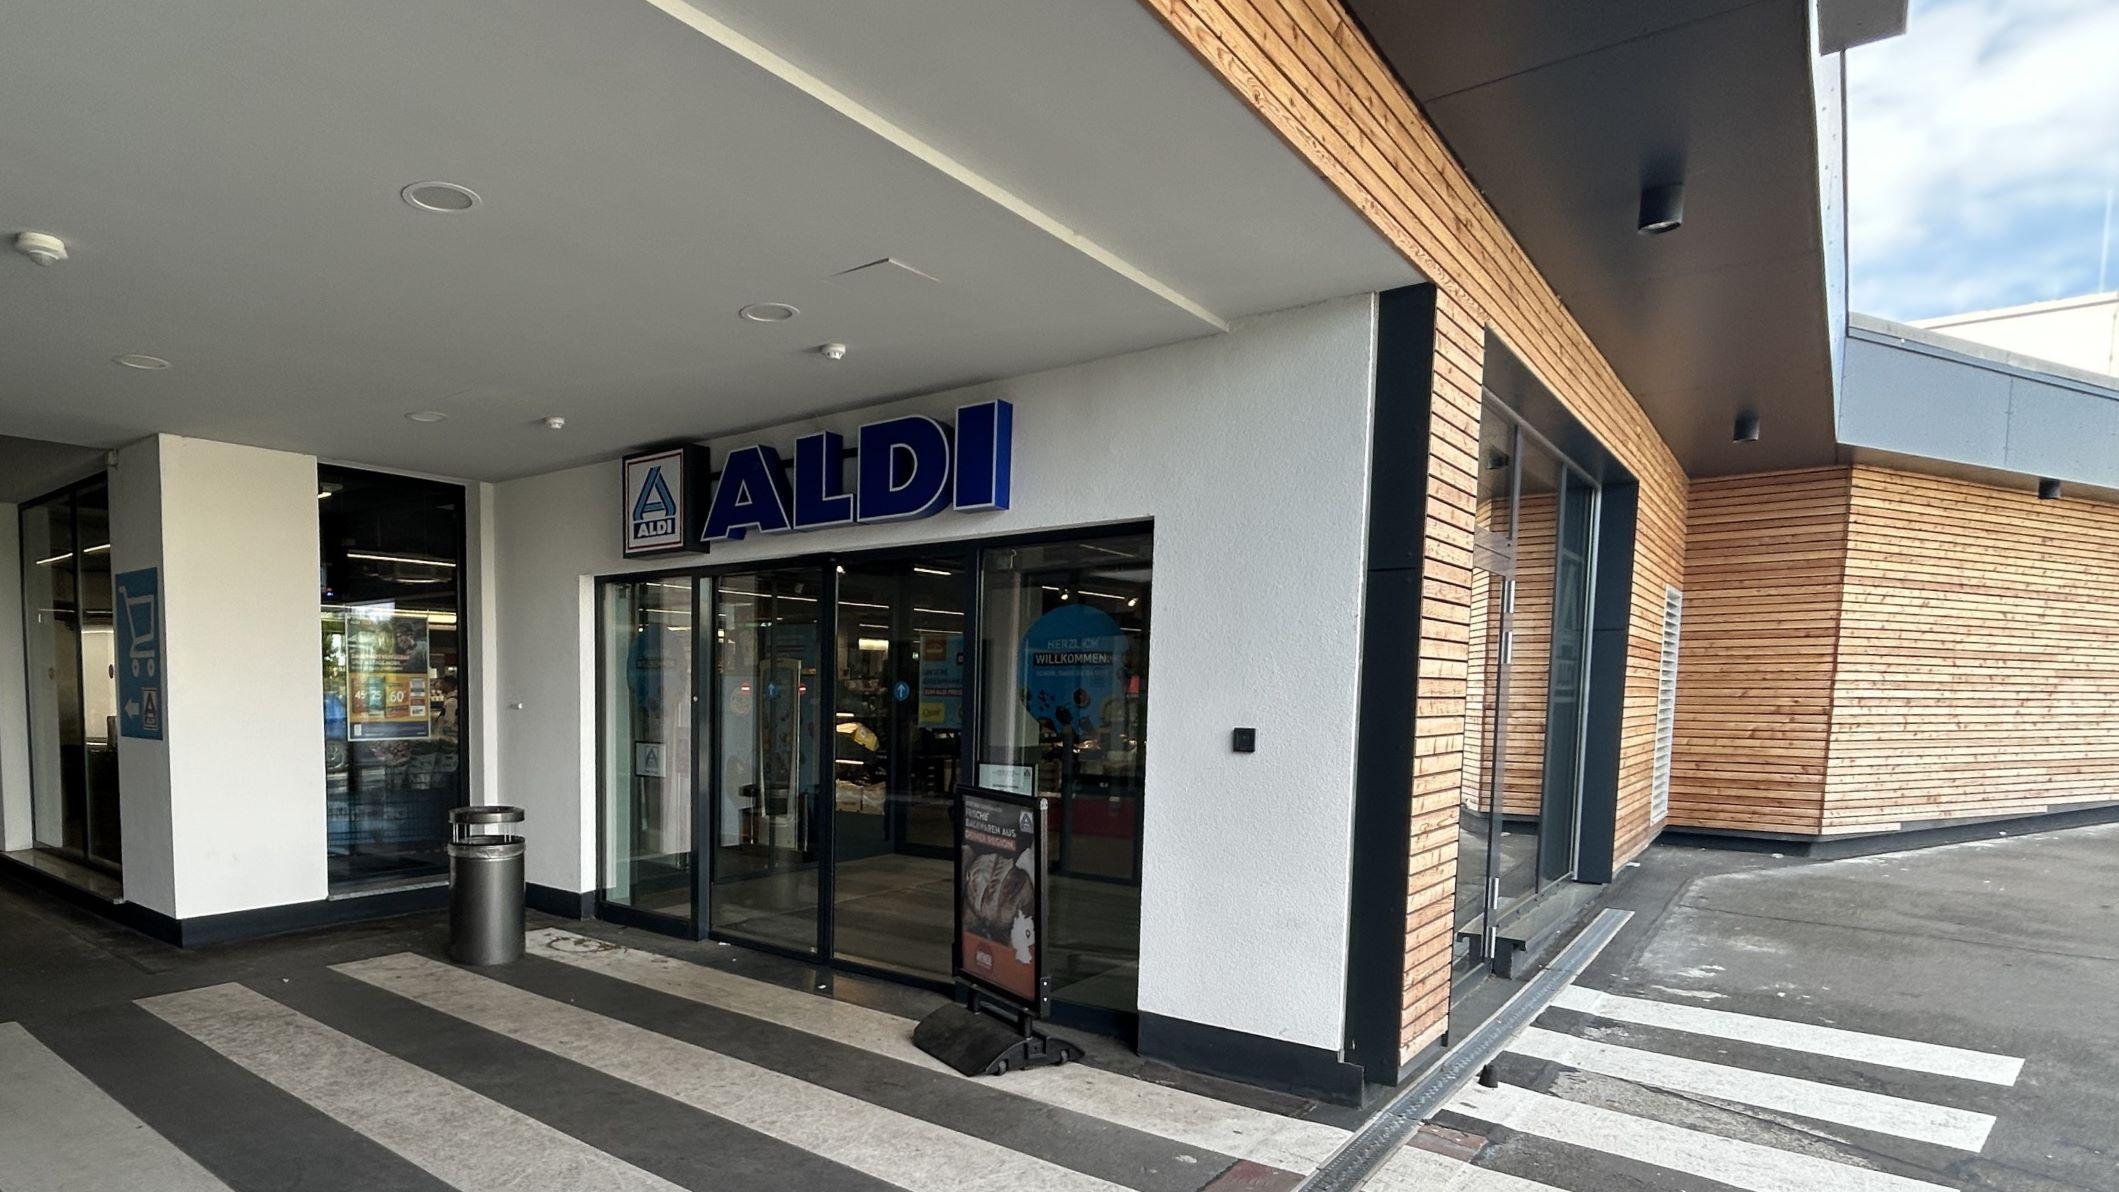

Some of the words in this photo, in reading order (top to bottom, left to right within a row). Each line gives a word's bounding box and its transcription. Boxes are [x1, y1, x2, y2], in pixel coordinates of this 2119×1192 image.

[701, 399, 1013, 542] ALDI
[636, 521, 674, 539] ALDI
[1047, 639, 1099, 650] HERZLICH
[1035, 653, 1110, 665] WILLKOMMEN.
